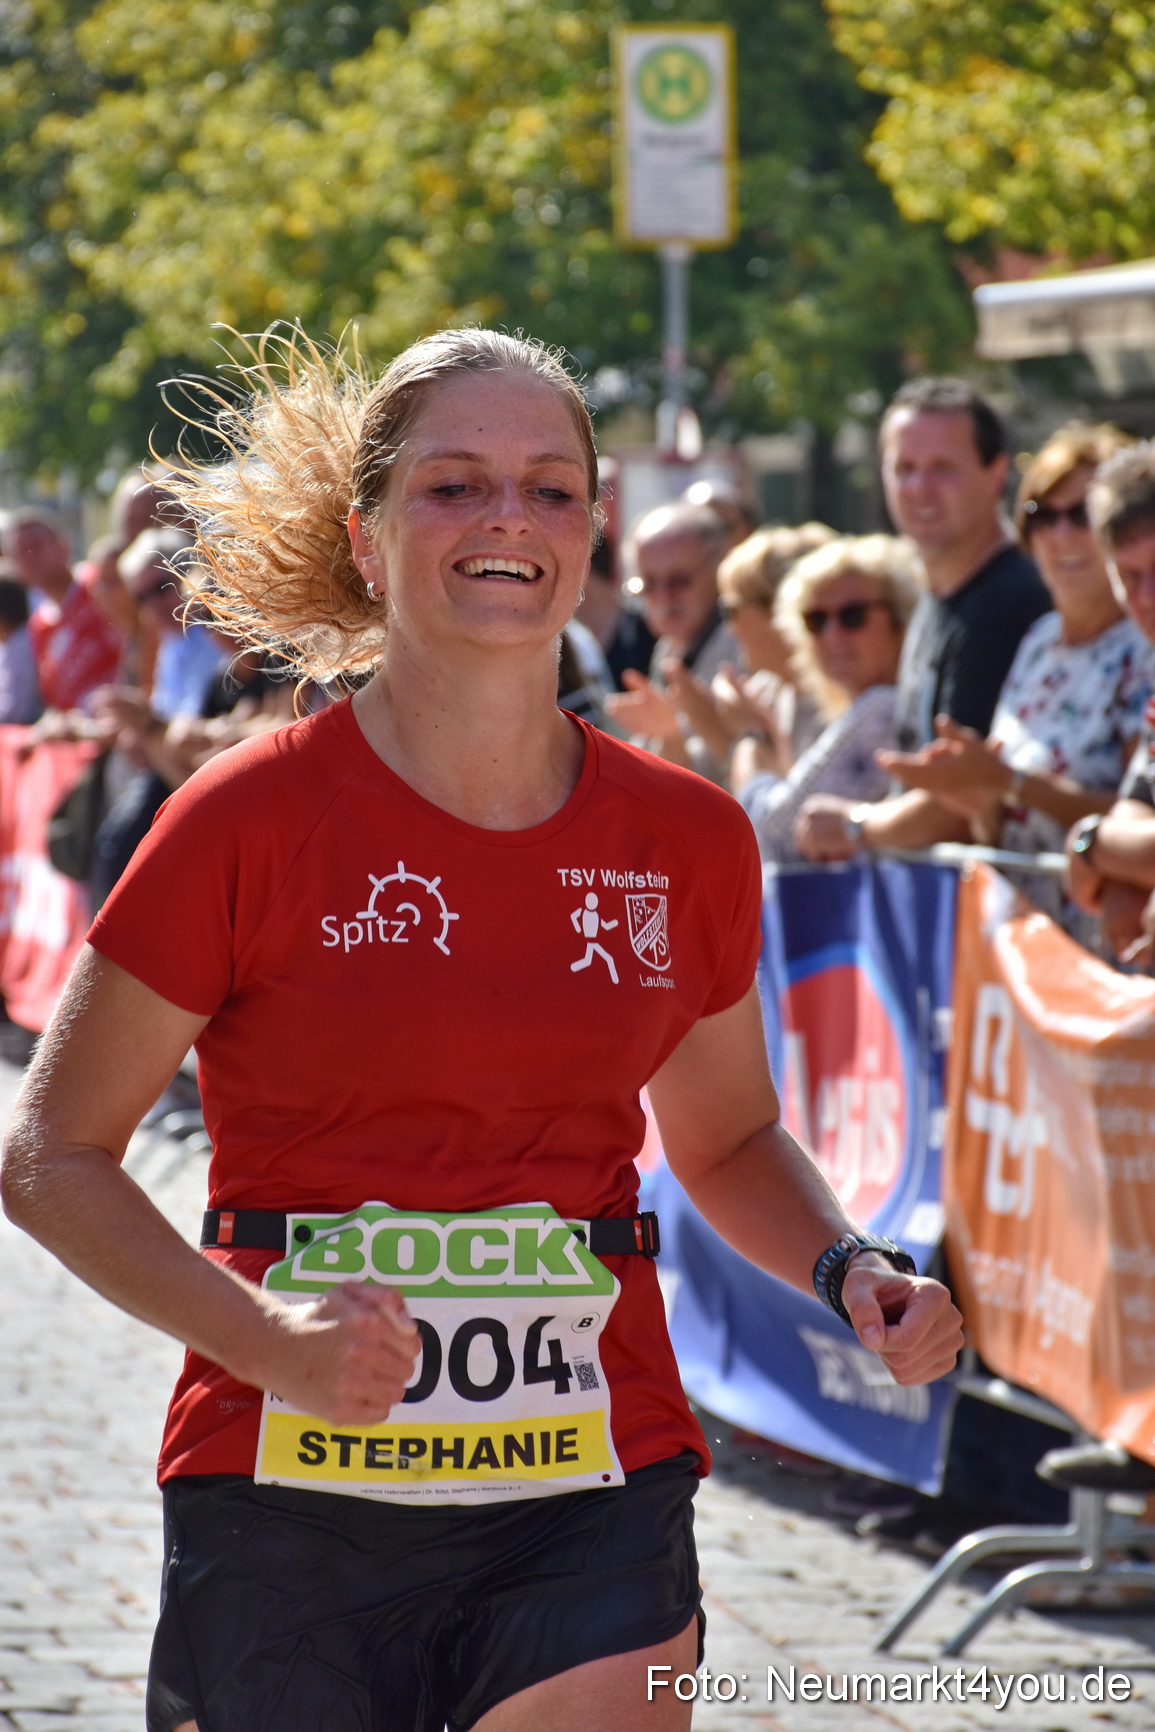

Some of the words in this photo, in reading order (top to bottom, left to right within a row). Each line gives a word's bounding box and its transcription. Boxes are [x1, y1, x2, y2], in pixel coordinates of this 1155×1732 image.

[557, 868, 595, 887] TSV
[600, 868, 669, 890] Wolfstein
[321, 915, 409, 953] Spitz
[293, 1219, 592, 1284] BOCK
[577, 1317, 594, 1329] B
[297, 1428, 579, 1469] STEPHANIE
